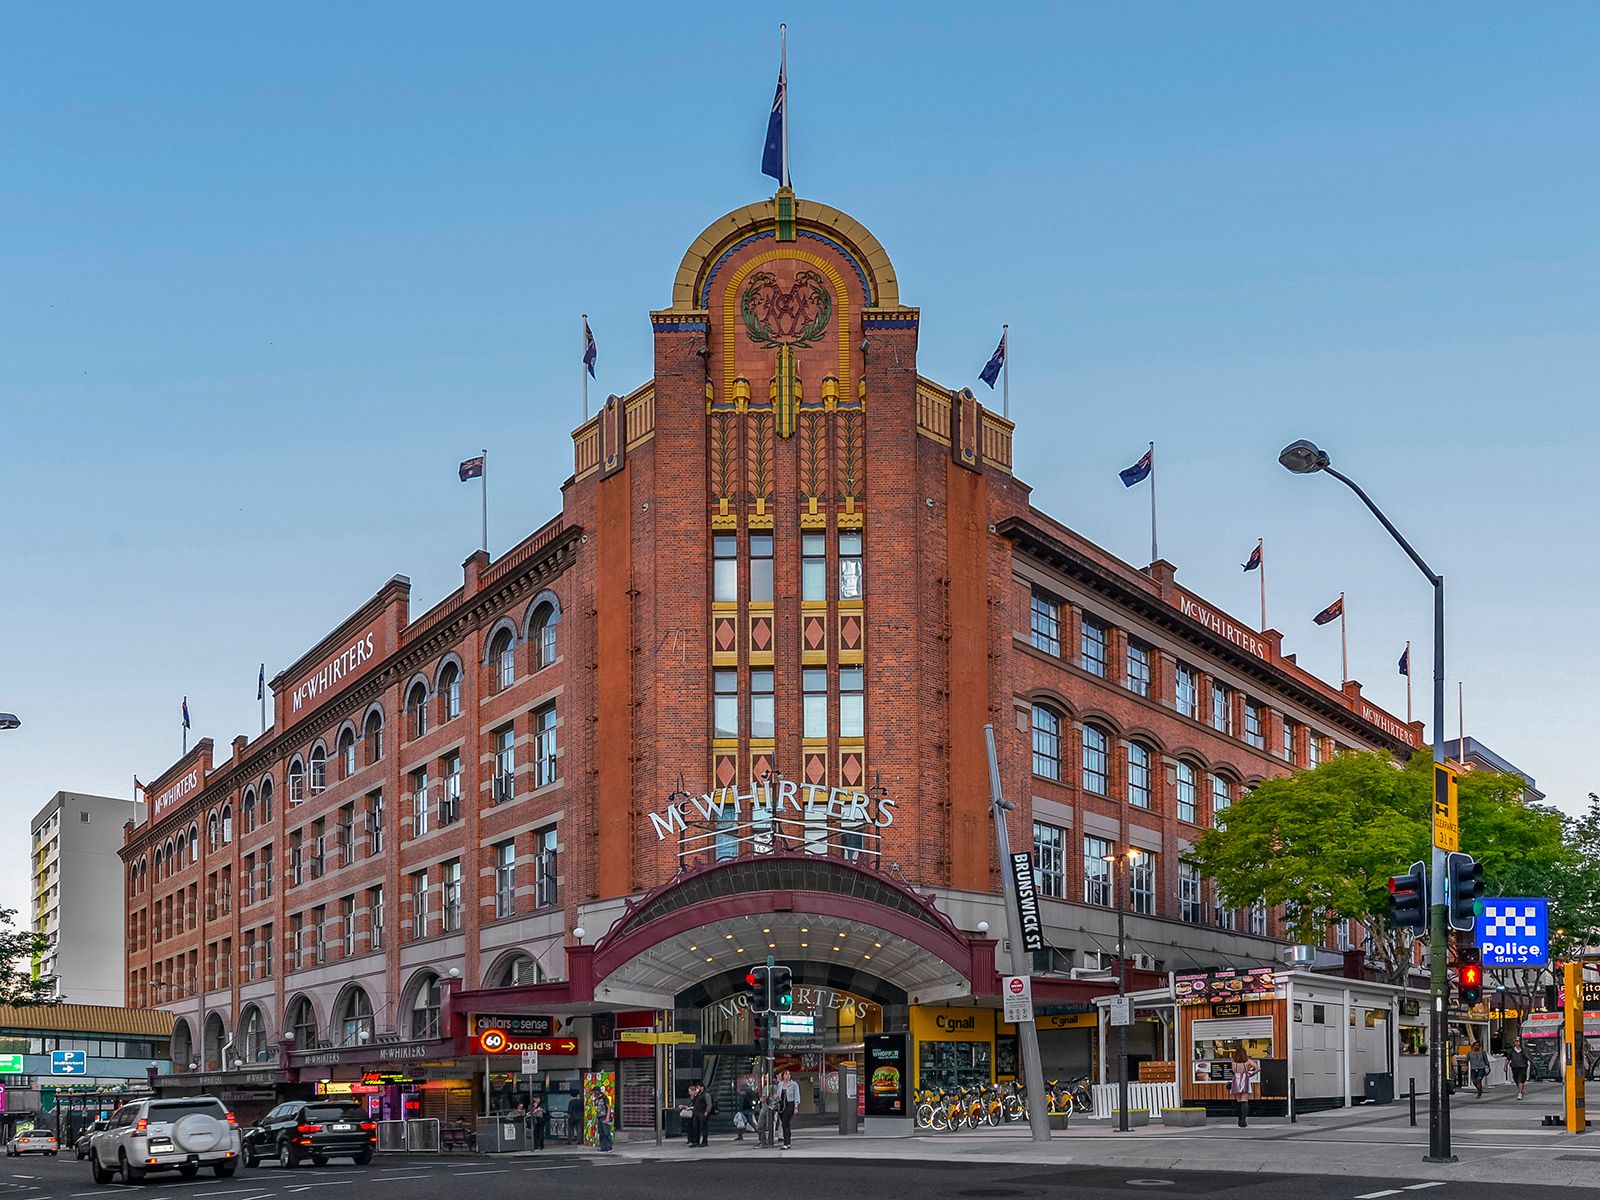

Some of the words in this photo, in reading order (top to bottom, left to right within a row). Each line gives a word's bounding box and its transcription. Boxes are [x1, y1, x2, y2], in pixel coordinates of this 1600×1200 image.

[1014, 852, 1039, 933] BRUNSWICK
[1025, 934, 1041, 951] ST
[1482, 942, 1541, 957] Police
[1494, 955, 1514, 963] 15m
[478, 1016, 511, 1029] dollars
[520, 1019, 548, 1030] sense
[936, 1014, 975, 1032] Cignall
[1051, 1015, 1079, 1027] Cignall
[485, 1035, 502, 1047] 60
